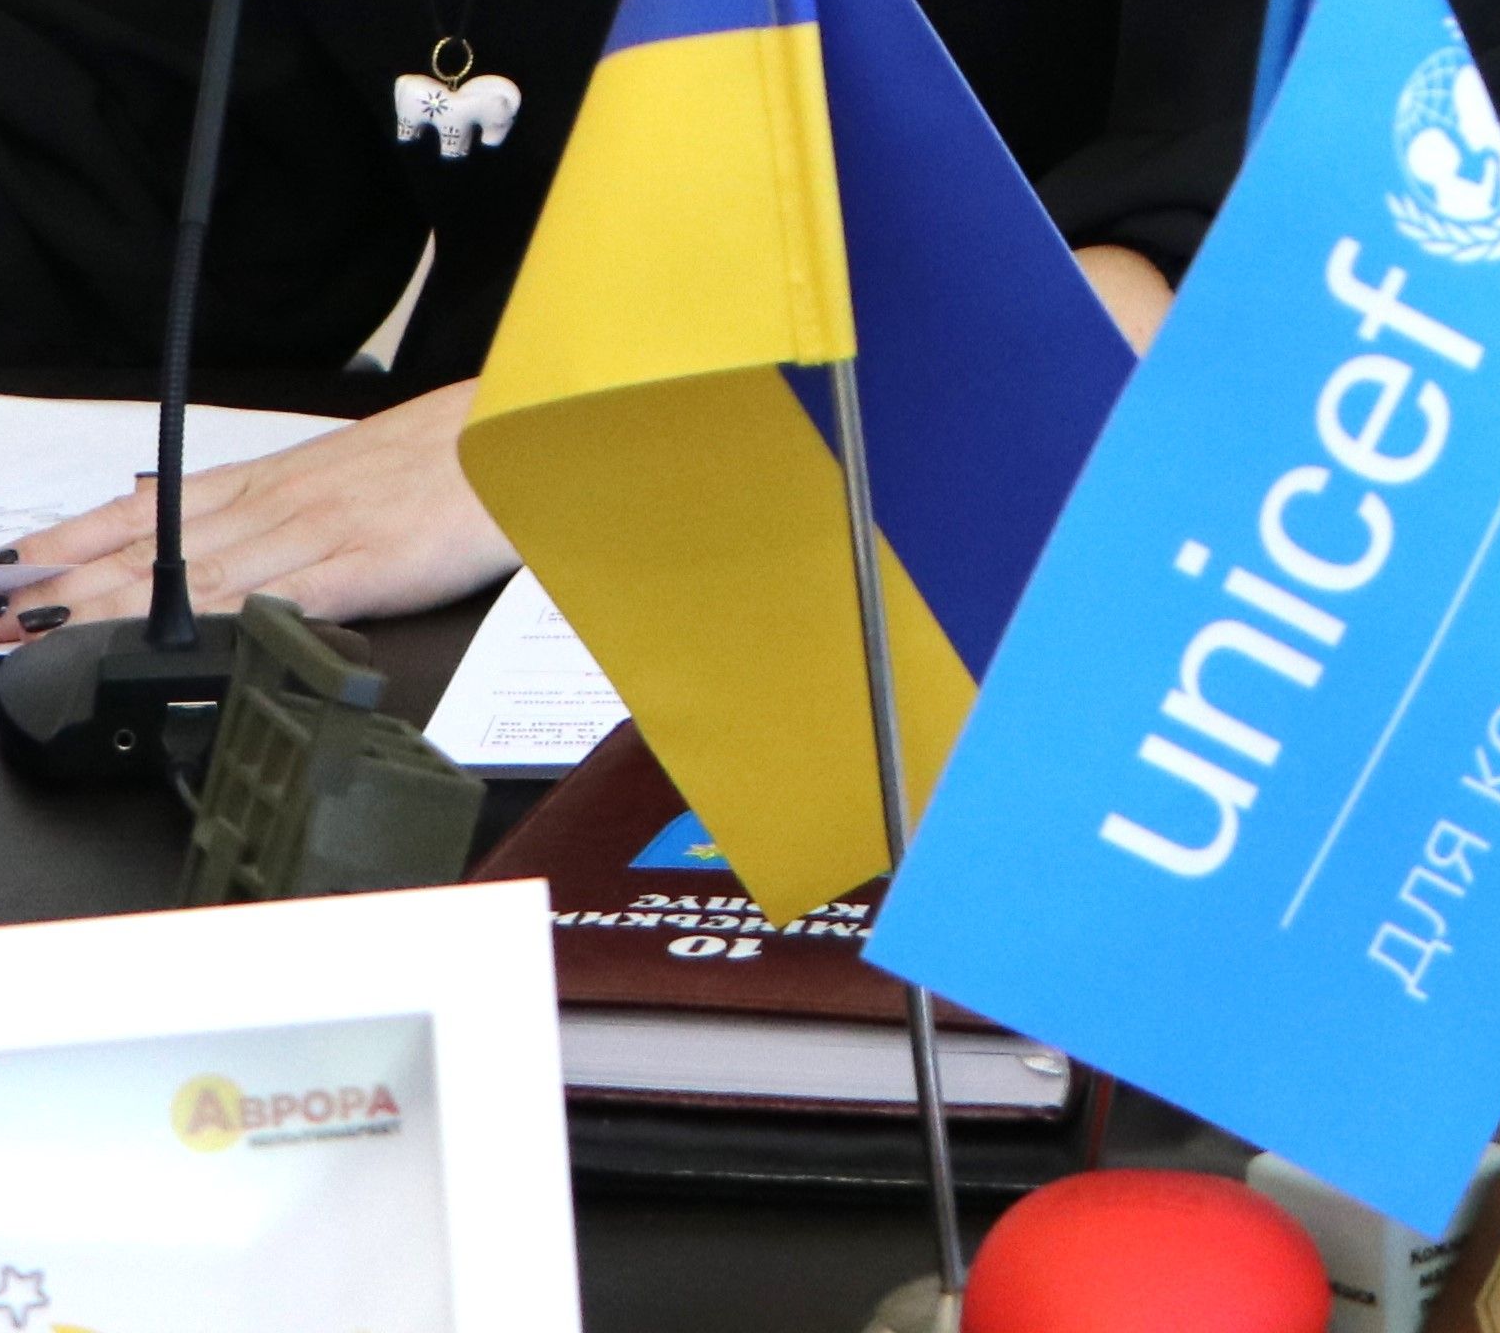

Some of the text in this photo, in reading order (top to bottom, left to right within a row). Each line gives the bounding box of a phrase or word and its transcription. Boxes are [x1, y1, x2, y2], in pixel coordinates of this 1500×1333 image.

[1100, 236, 1485, 878] unicef
[667, 934, 763, 959] 10
[1367, 819, 1492, 1001] ДЛЯ
